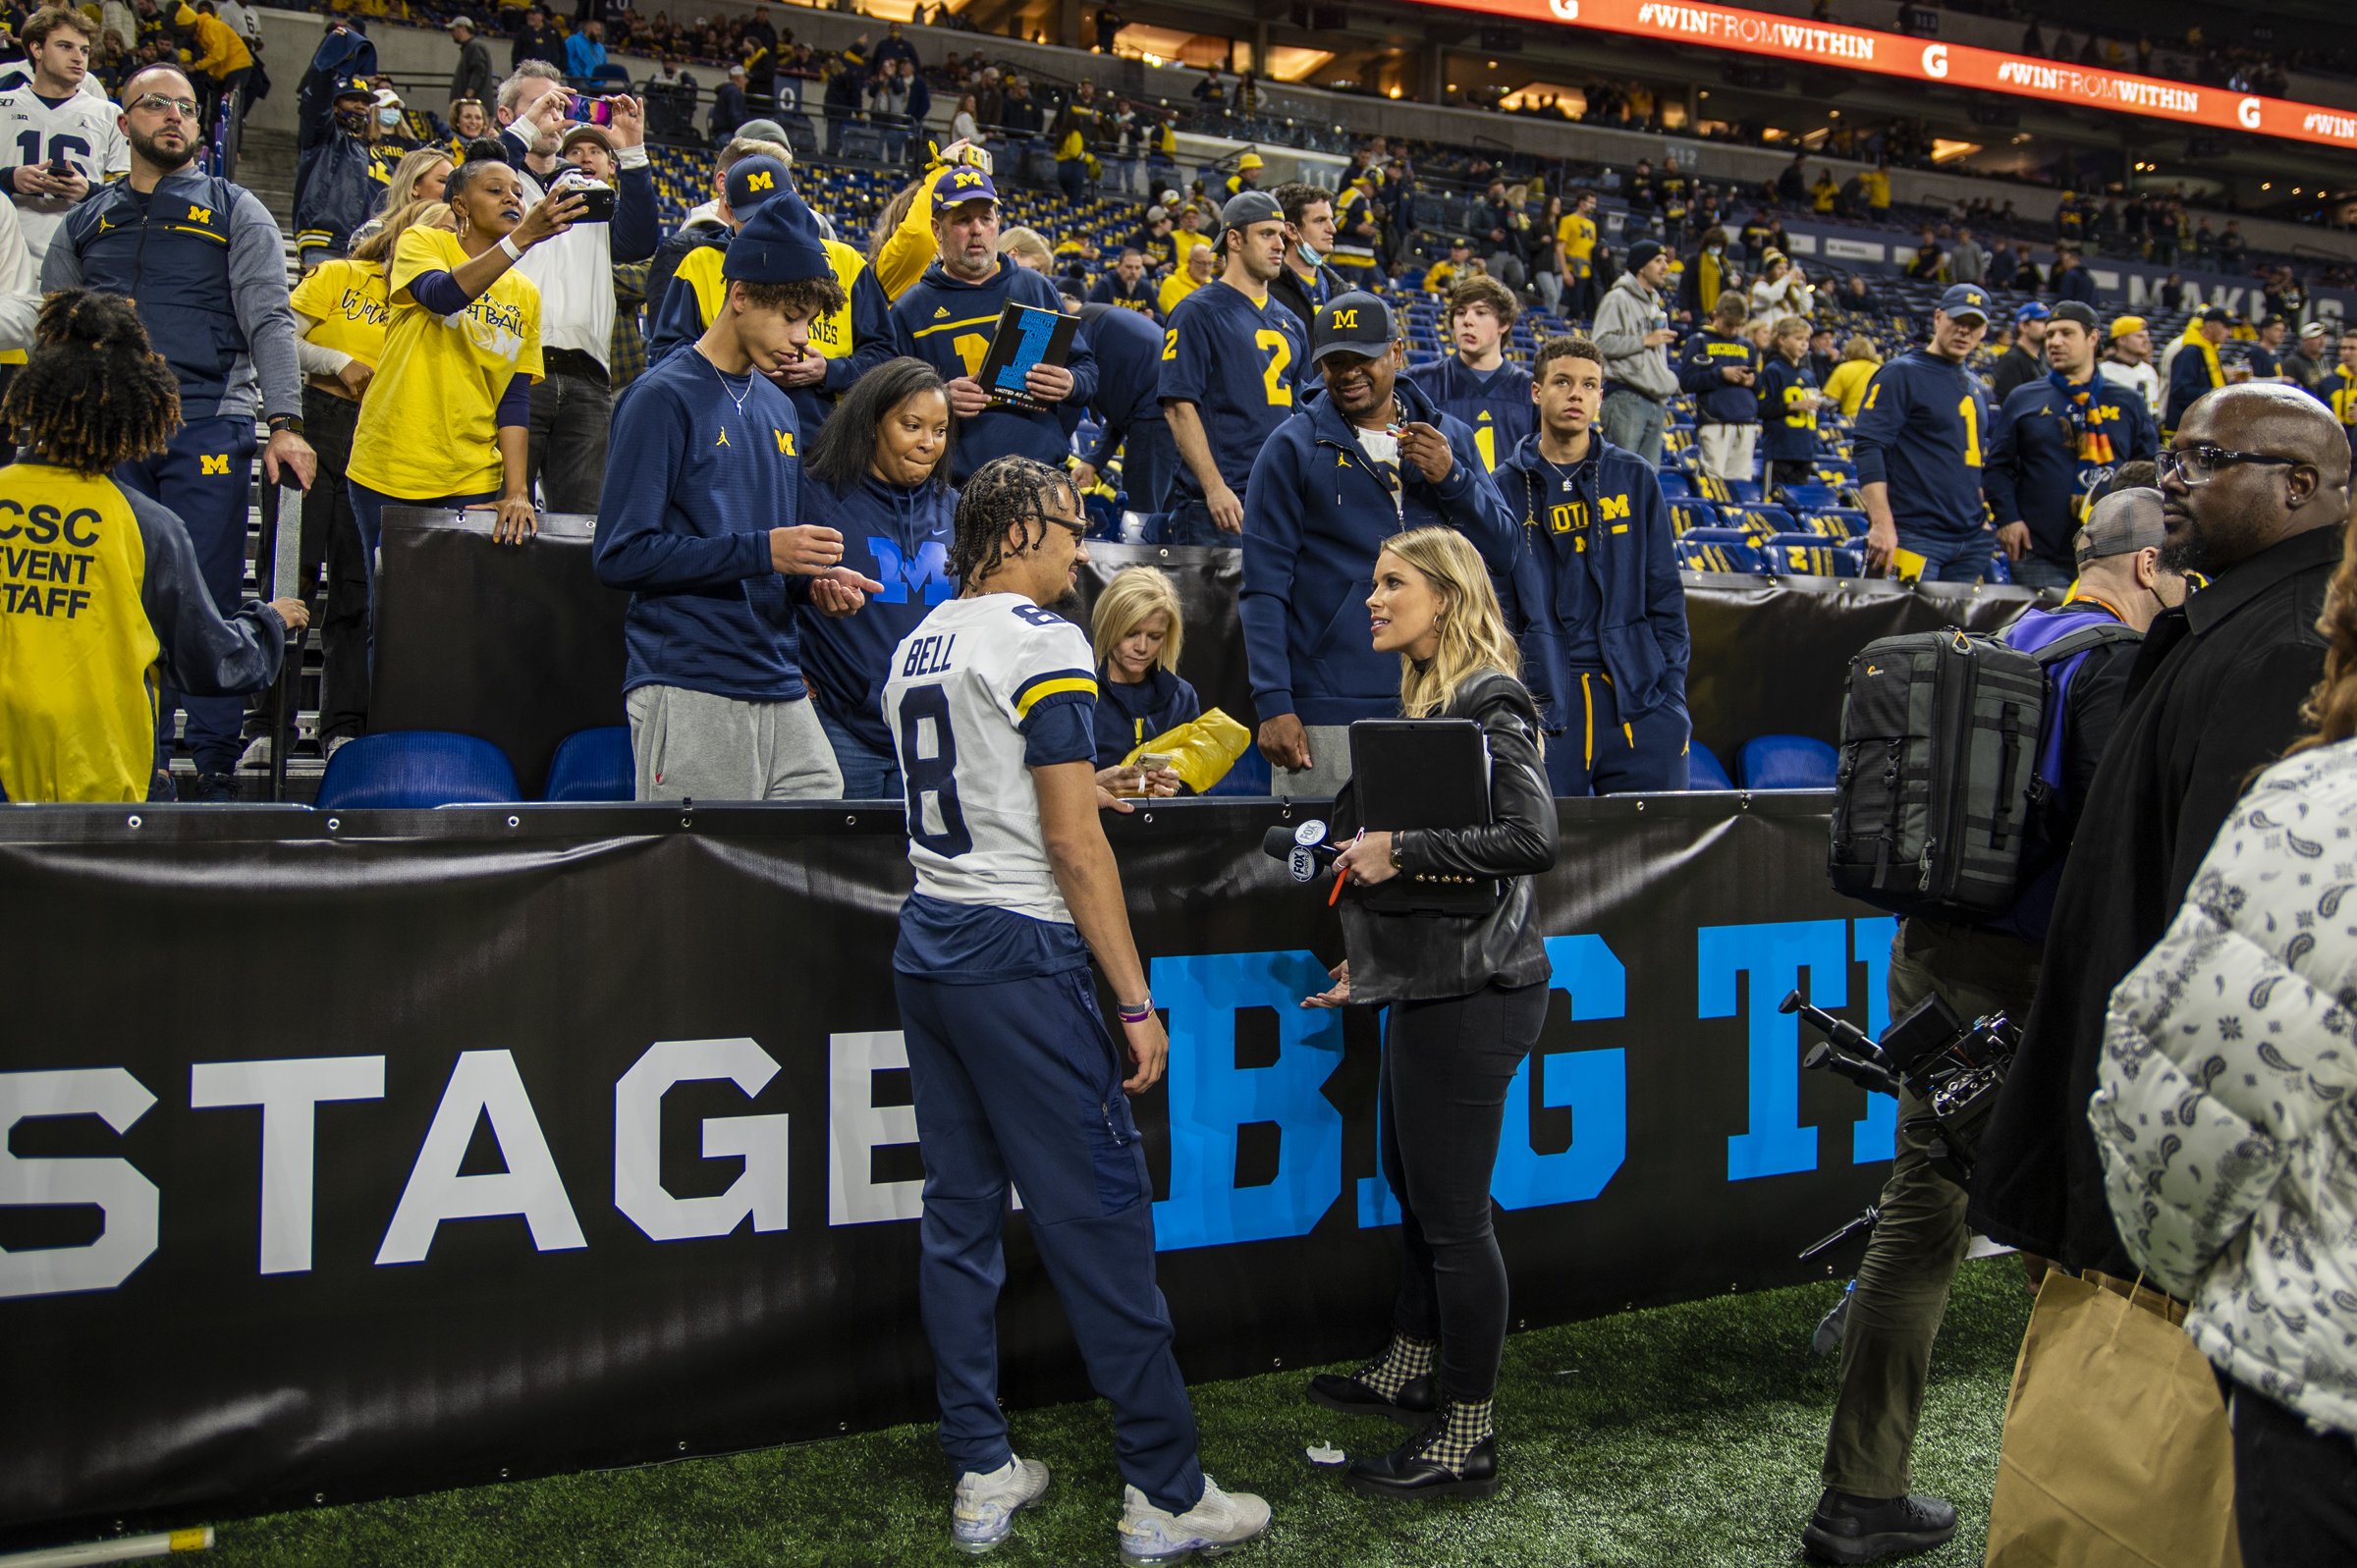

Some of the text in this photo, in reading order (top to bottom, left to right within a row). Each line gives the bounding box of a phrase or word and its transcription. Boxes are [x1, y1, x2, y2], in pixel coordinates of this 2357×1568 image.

[1921, 44, 1947, 79] G
[2237, 97, 2261, 129] G
[746, 171, 775, 192] M
[953, 171, 984, 189] M
[188, 205, 212, 225] M
[1333, 309, 1358, 330] M
[1162, 328, 1178, 361] 2
[1254, 328, 1292, 407] 2
[1864, 383, 1881, 409] 1
[774, 429, 798, 457] M
[1958, 395, 1982, 467] 1
[200, 454, 231, 474] M
[1599, 493, 1631, 521] M
[0, 499, 102, 548] CSC
[0, 546, 94, 585] VENT
[867, 536, 953, 606] M
[0, 583, 90, 619] TAFF
[1012, 604, 1068, 626] 8
[903, 633, 956, 677] BELL
[899, 683, 973, 860] 8
[1299, 824, 1318, 839] FOX
[1293, 852, 1305, 875] FOX
[1151, 934, 1626, 1253] BG
